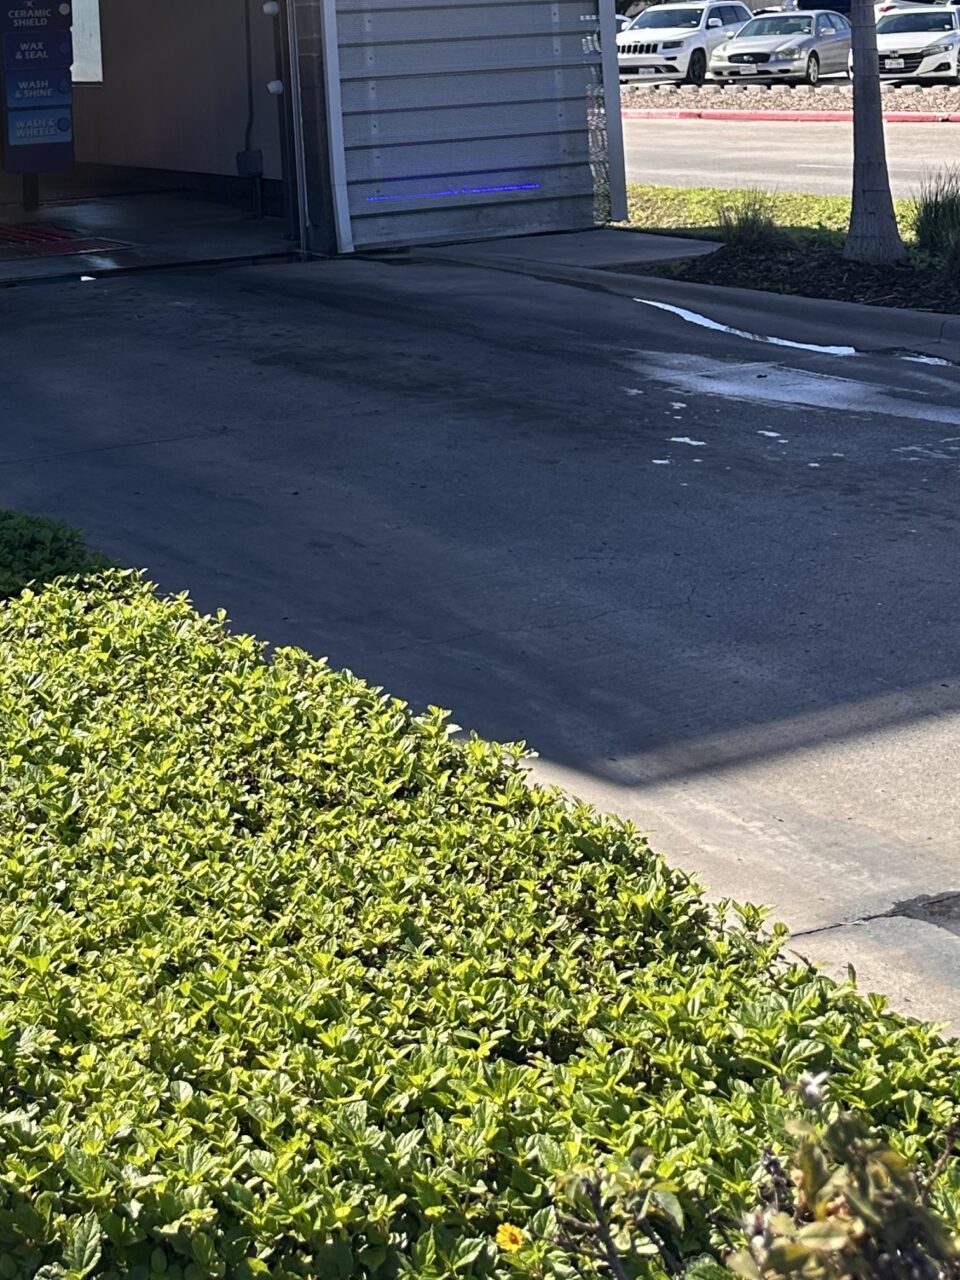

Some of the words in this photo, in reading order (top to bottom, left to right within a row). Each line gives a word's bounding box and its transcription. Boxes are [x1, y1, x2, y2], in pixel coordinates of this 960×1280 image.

[8, 9, 52, 18] CERAMIC
[13, 18, 48, 27] SHIELD
[20, 42, 44, 51] WAX
[24, 50, 48, 59] SEAL
[18, 80, 48, 89] WASH
[23, 88, 53, 97] SHINE
